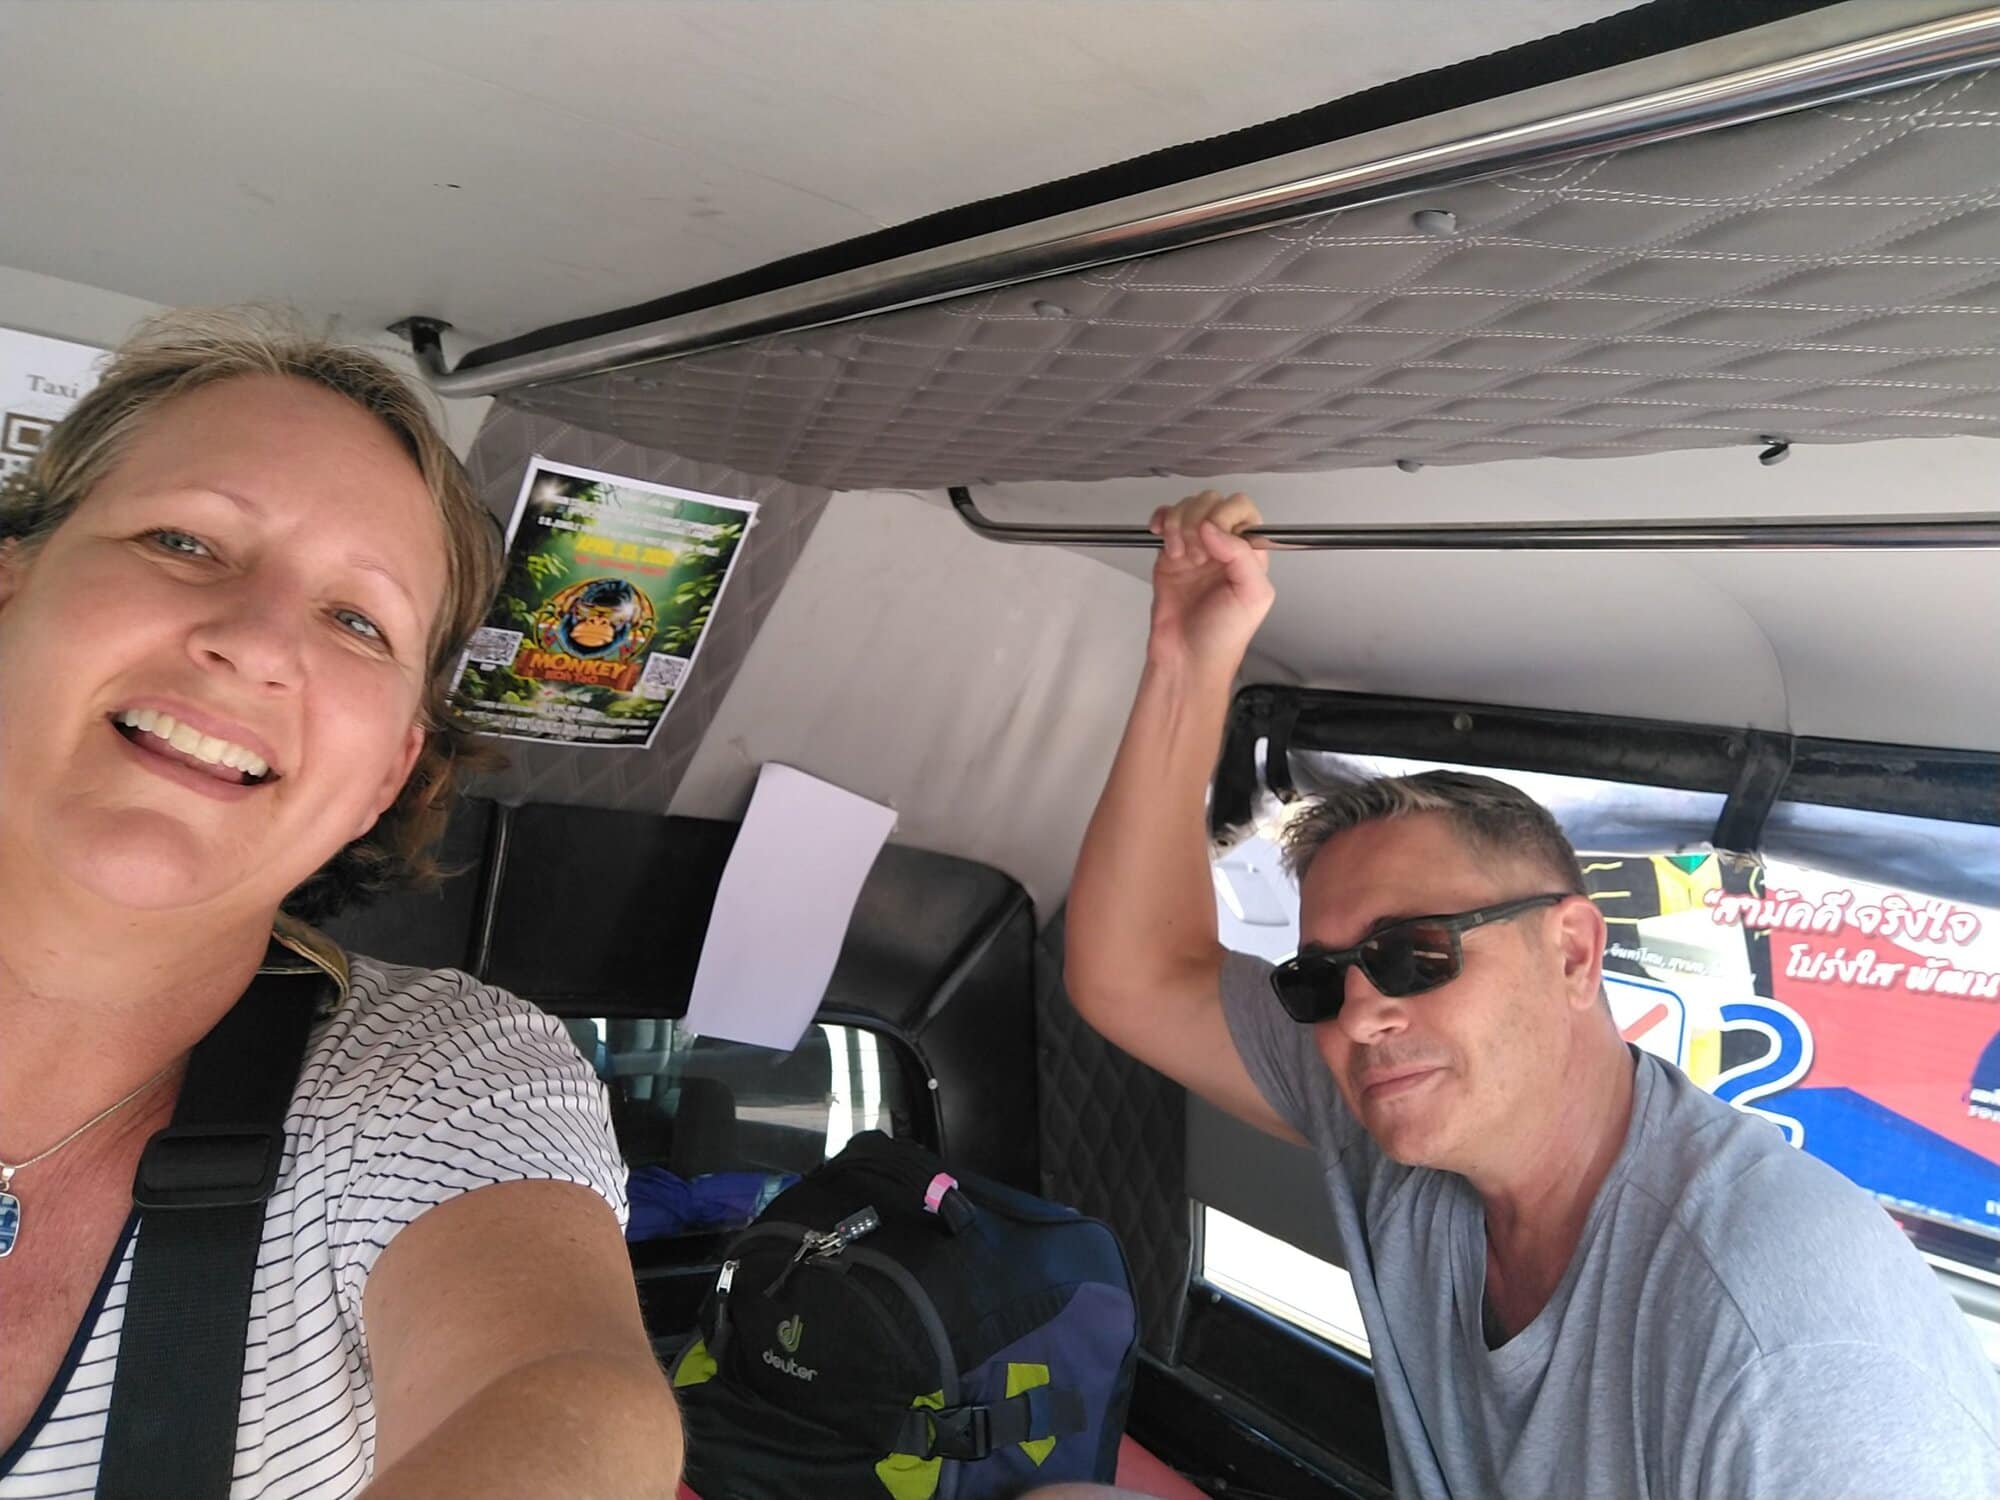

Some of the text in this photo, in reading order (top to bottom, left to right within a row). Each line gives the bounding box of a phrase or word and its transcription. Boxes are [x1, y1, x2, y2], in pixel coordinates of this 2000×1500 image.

[27, 374, 80, 399] Taxi
[529, 652, 628, 679] MONKEY
[762, 1348, 818, 1381] deuter
